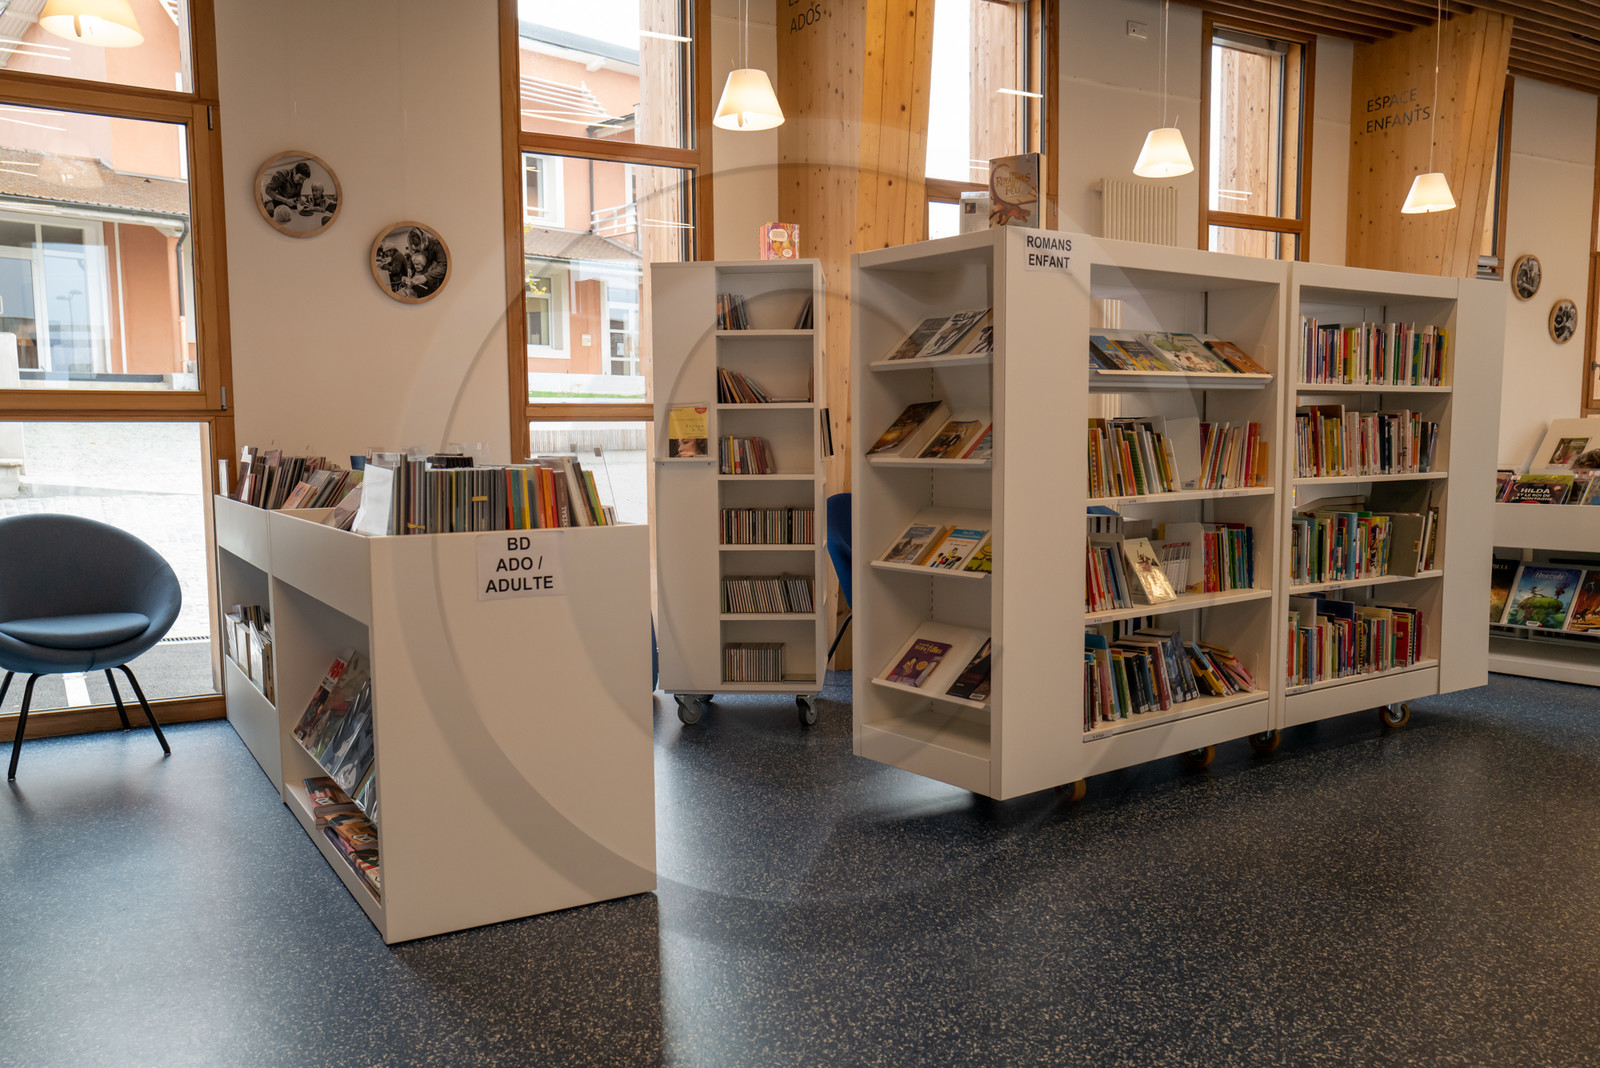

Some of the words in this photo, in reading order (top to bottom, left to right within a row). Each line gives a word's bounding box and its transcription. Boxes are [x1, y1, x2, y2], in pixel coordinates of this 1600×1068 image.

[790, 4, 821, 35] ADOS
[1367, 88, 1417, 112] ESPACE
[1366, 106, 1431, 134] ENFANTS
[1026, 235, 1072, 252] ROMANS
[1028, 253, 1070, 269] ENFANT
[507, 537, 531, 551] BD
[496, 557, 533, 572] ADO
[538, 555, 543, 570] /
[485, 575, 554, 593] ADULTE
